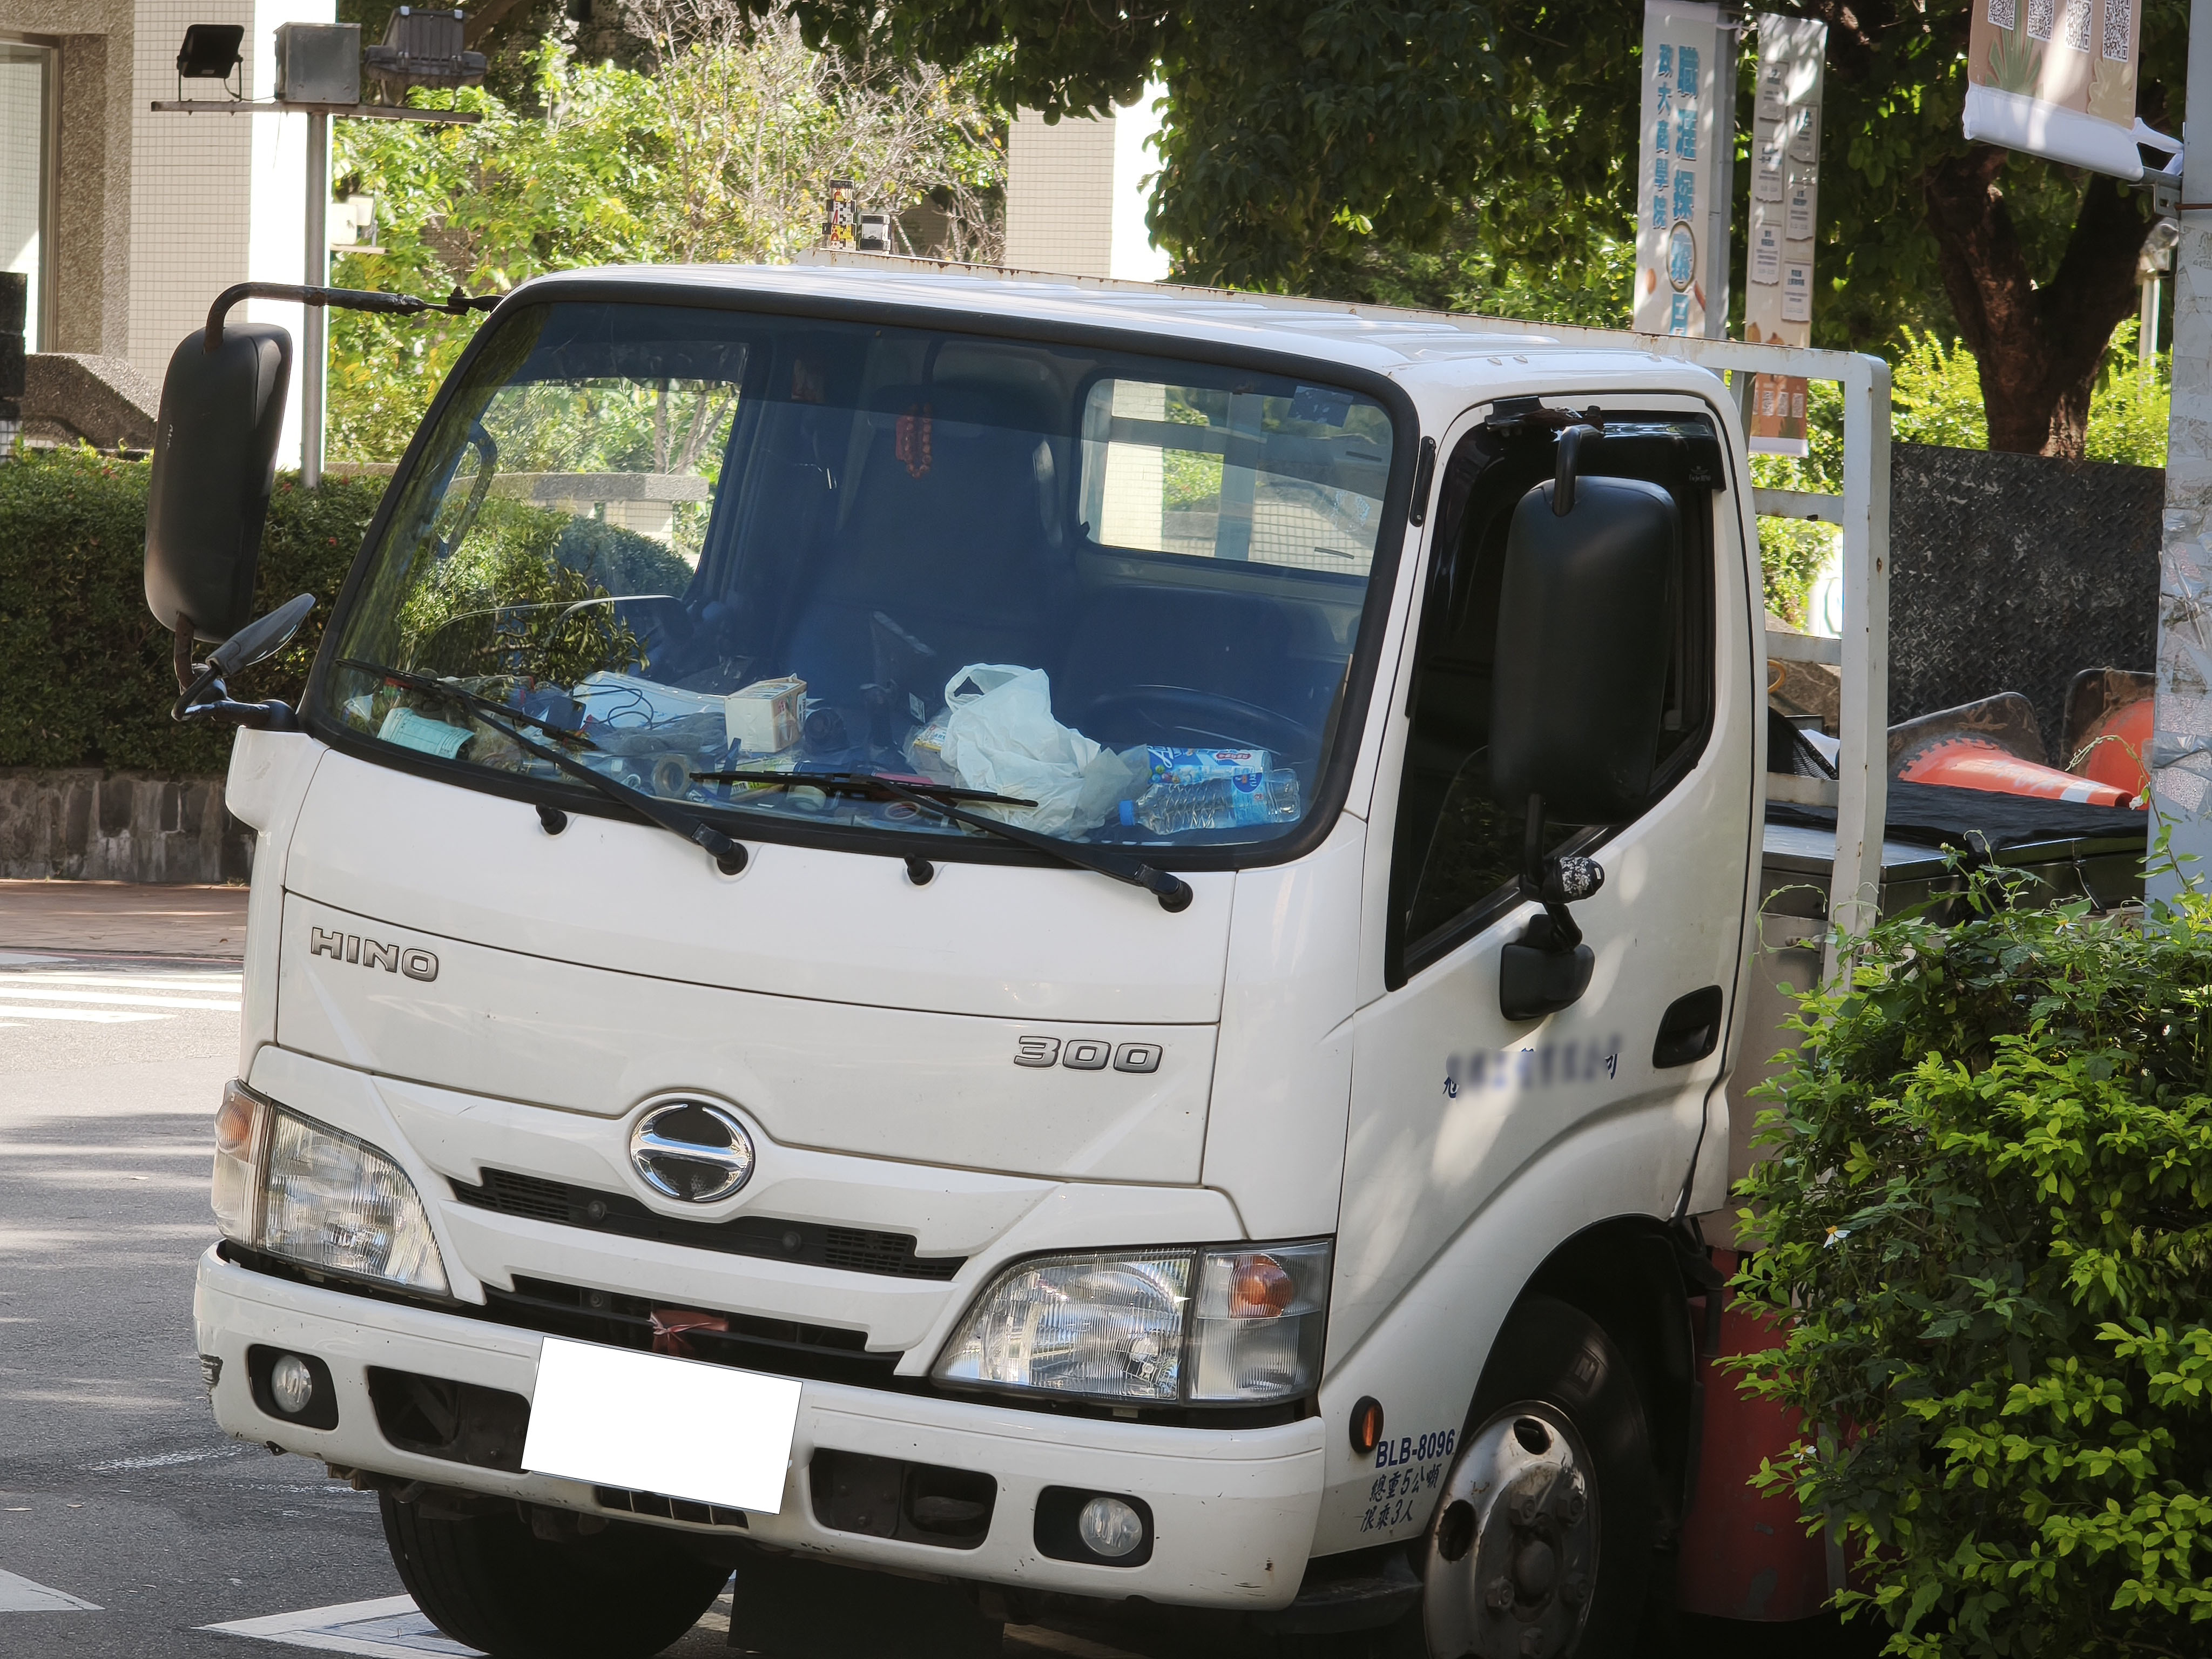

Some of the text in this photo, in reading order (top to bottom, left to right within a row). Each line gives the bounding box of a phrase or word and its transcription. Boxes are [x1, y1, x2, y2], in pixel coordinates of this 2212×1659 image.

[311, 927, 439, 982] HINO
[1011, 1035, 1163, 1074] 300
[1375, 1429, 1455, 1468] BLB-8096
[1369, 1464, 1442, 1502] 總重5公噸
[1360, 1499, 1413, 1532] 限乘3人
